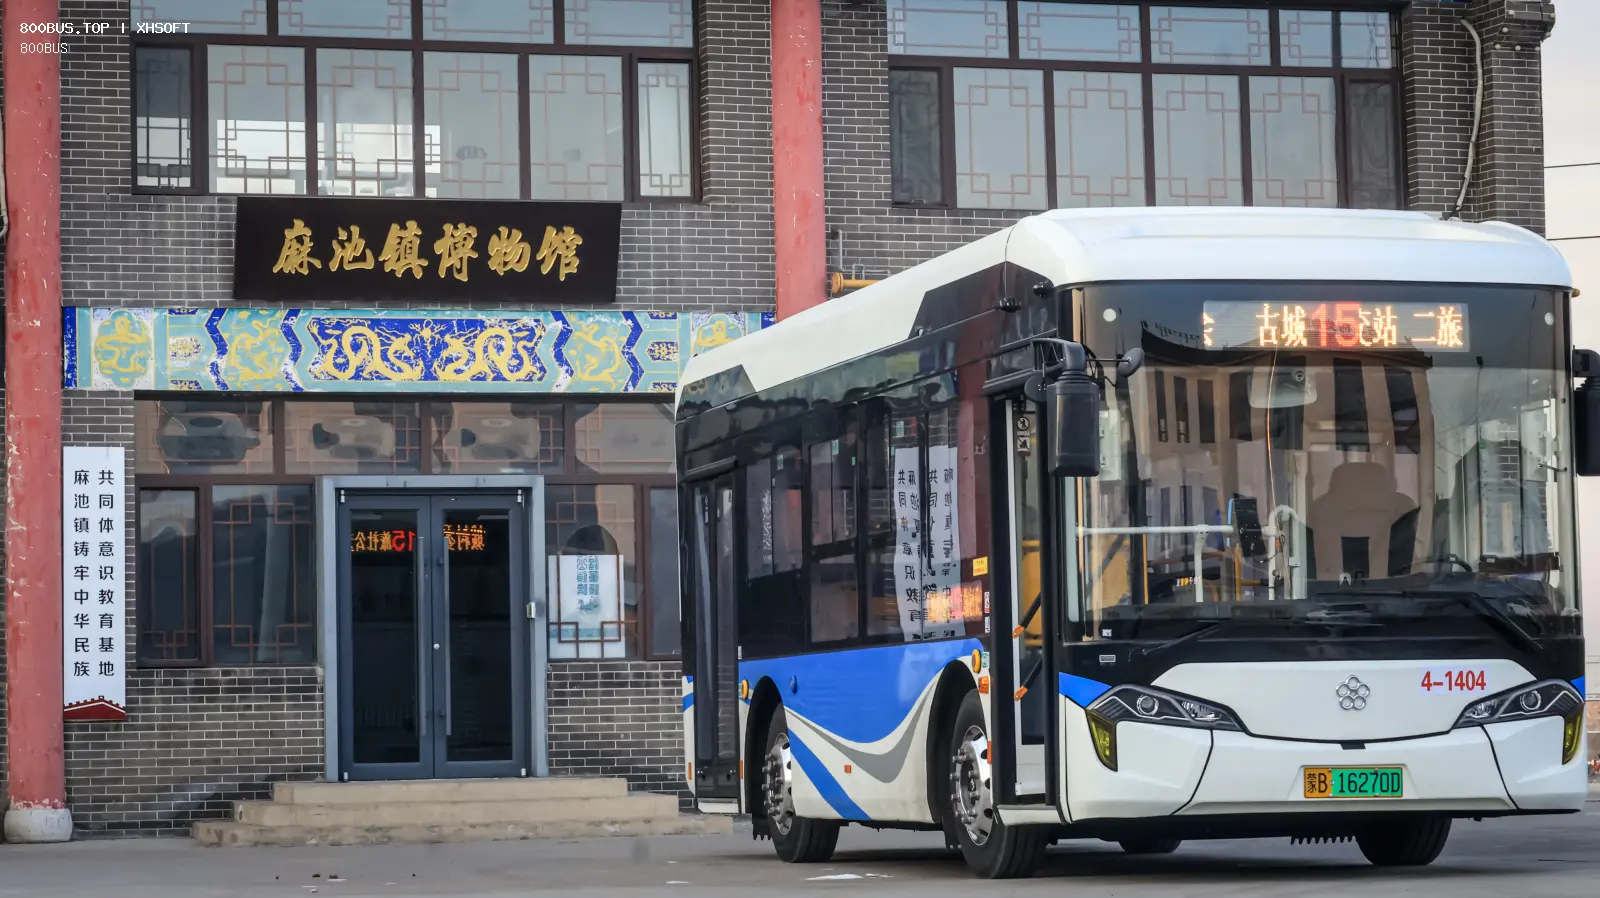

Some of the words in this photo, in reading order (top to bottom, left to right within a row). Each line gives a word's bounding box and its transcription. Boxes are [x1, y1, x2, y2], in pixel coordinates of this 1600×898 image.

[272, 218, 584, 283] 麻池镇博物馆
[1256, 303, 1308, 347] 古城
[1311, 303, 1361, 347] 15
[1411, 306, 1463, 347] 二旅
[73, 469, 90, 677] 麻池镇铸牢中华民族
[98, 469, 115, 677] 共同体意识教育基地
[1421, 670, 1487, 691] 4-1404
[1307, 772, 1328, 793] 蒙B
[1338, 772, 1400, 793] 16270D
